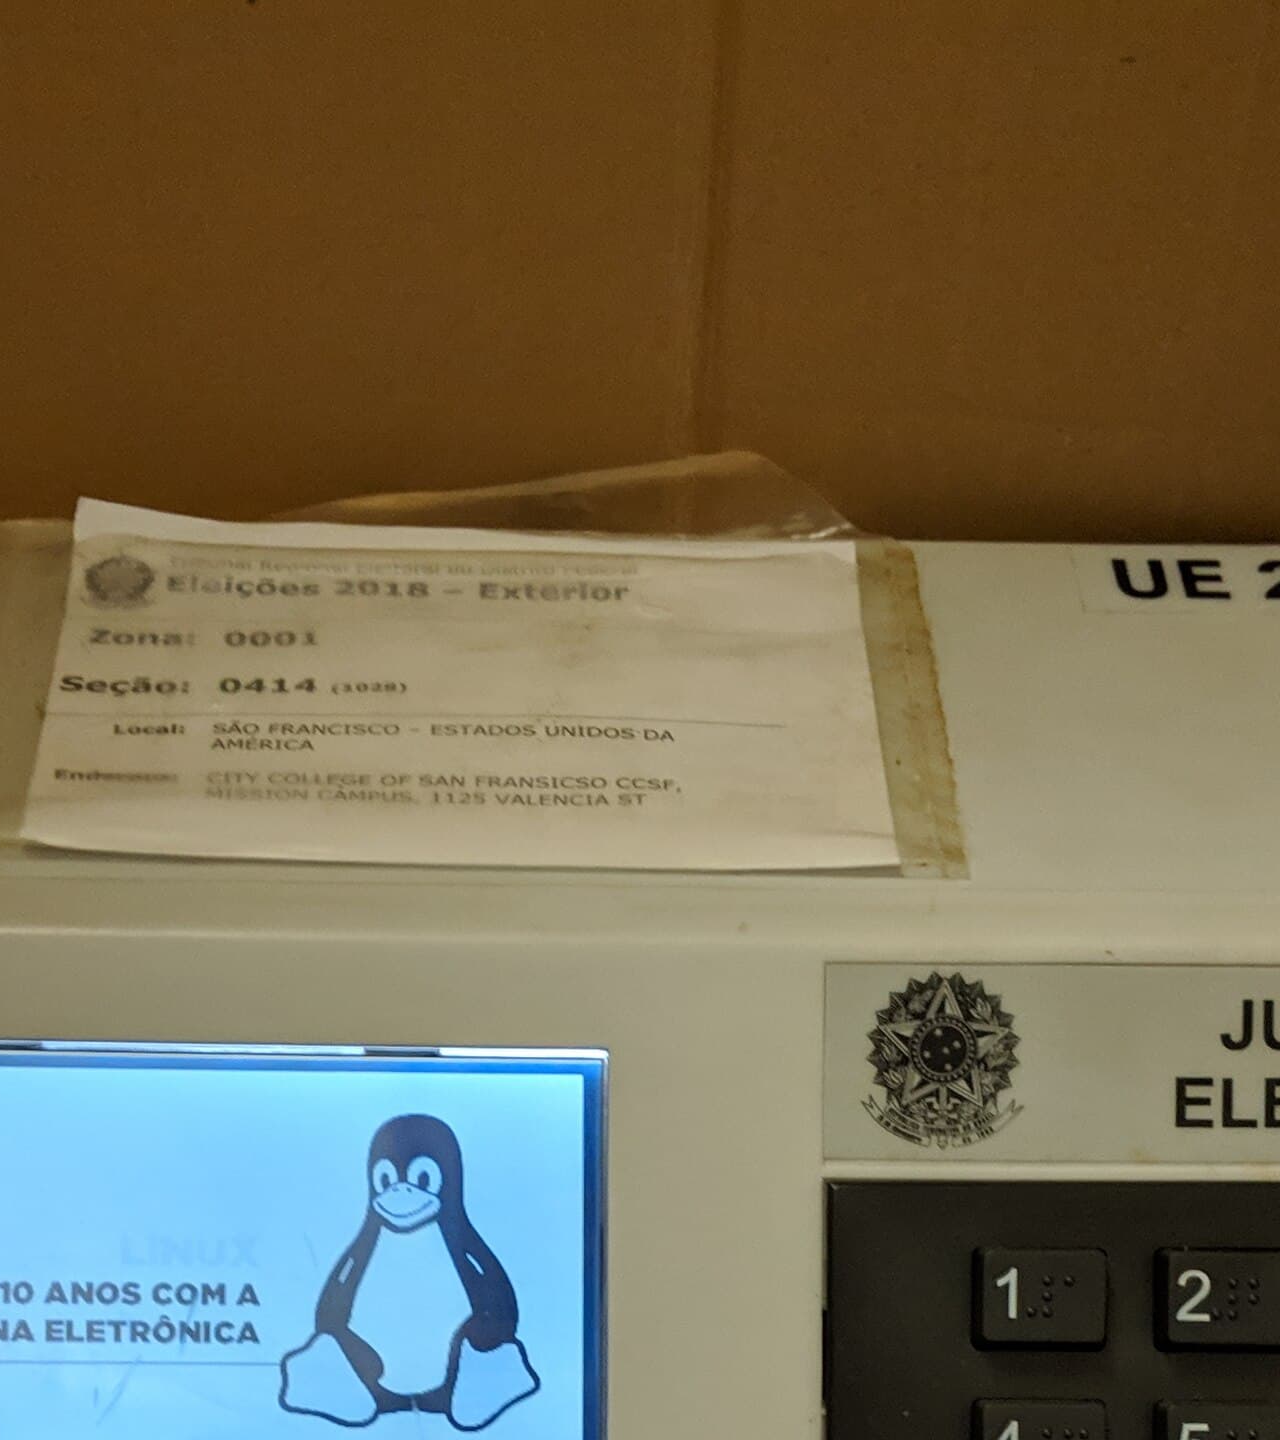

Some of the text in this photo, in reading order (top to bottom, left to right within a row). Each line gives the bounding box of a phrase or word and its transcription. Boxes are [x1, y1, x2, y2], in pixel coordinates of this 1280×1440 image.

[167, 575, 320, 598] Eleições
[335, 579, 430, 599] 2018
[479, 582, 630, 602] Exterior
[1112, 559, 1231, 599] UE
[224, 631, 319, 648] 0001
[59, 676, 190, 697] Seção:
[219, 677, 317, 695] 0414
[212, 720, 260, 736] SÃO
[269, 721, 400, 736] FRANCISCO
[431, 724, 537, 738] ESTADOS
[544, 726, 635, 740] UNIDOS
[642, 728, 674, 742] DA
[211, 735, 315, 751] AMÉRICA
[380, 775, 413, 787] OF
[419, 776, 465, 788] SAN
[616, 778, 681, 793] CCSF,
[431, 791, 486, 805] 1125
[494, 792, 609, 807] VALENCIA
[617, 794, 647, 807] ST
[44, 1282, 142, 1305] ANOS
[152, 1282, 226, 1306] COM
[236, 1283, 261, 1306] A
[994, 1266, 1019, 1320] 1
[1176, 1269, 1211, 1322] 2
[45, 1315, 261, 1344] ELETRÔNICA
